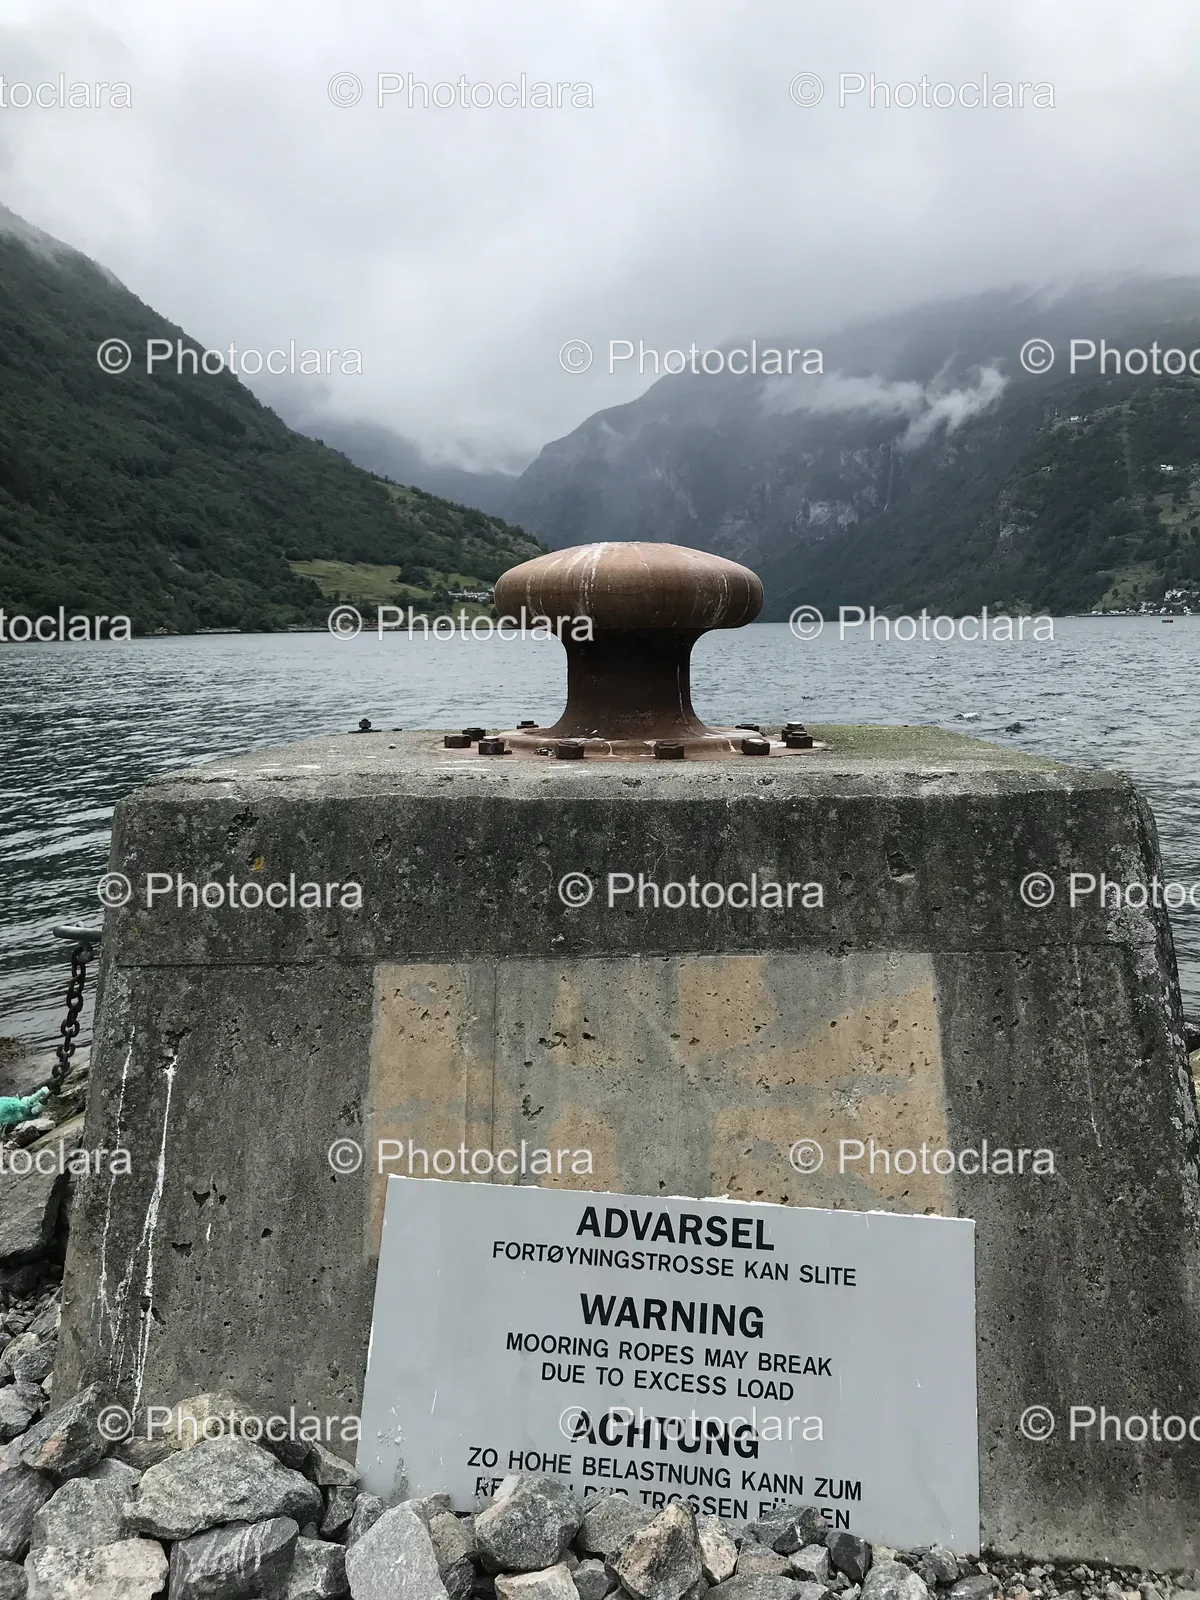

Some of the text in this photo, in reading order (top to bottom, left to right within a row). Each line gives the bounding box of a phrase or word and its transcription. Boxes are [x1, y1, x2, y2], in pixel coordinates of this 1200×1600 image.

[576, 1206, 774, 1251] ADVARSEL
[492, 1240, 857, 1287] FORTØYNINGSTROSSE KAN SLITE
[580, 1293, 764, 1338] WARNING
[506, 1332, 832, 1376] MOORING ROPES MAY BREAK
[541, 1362, 794, 1400] DUE TO EXCESS LOAD
[570, 1410, 759, 1459] ACHTUNG
[467, 1447, 499, 1468] ZO
[508, 1450, 572, 1474] HOHE
[582, 1456, 731, 1489] BELASTNUNG
[741, 1470, 804, 1495] KANN
[813, 1477, 862, 1501] ZUM
